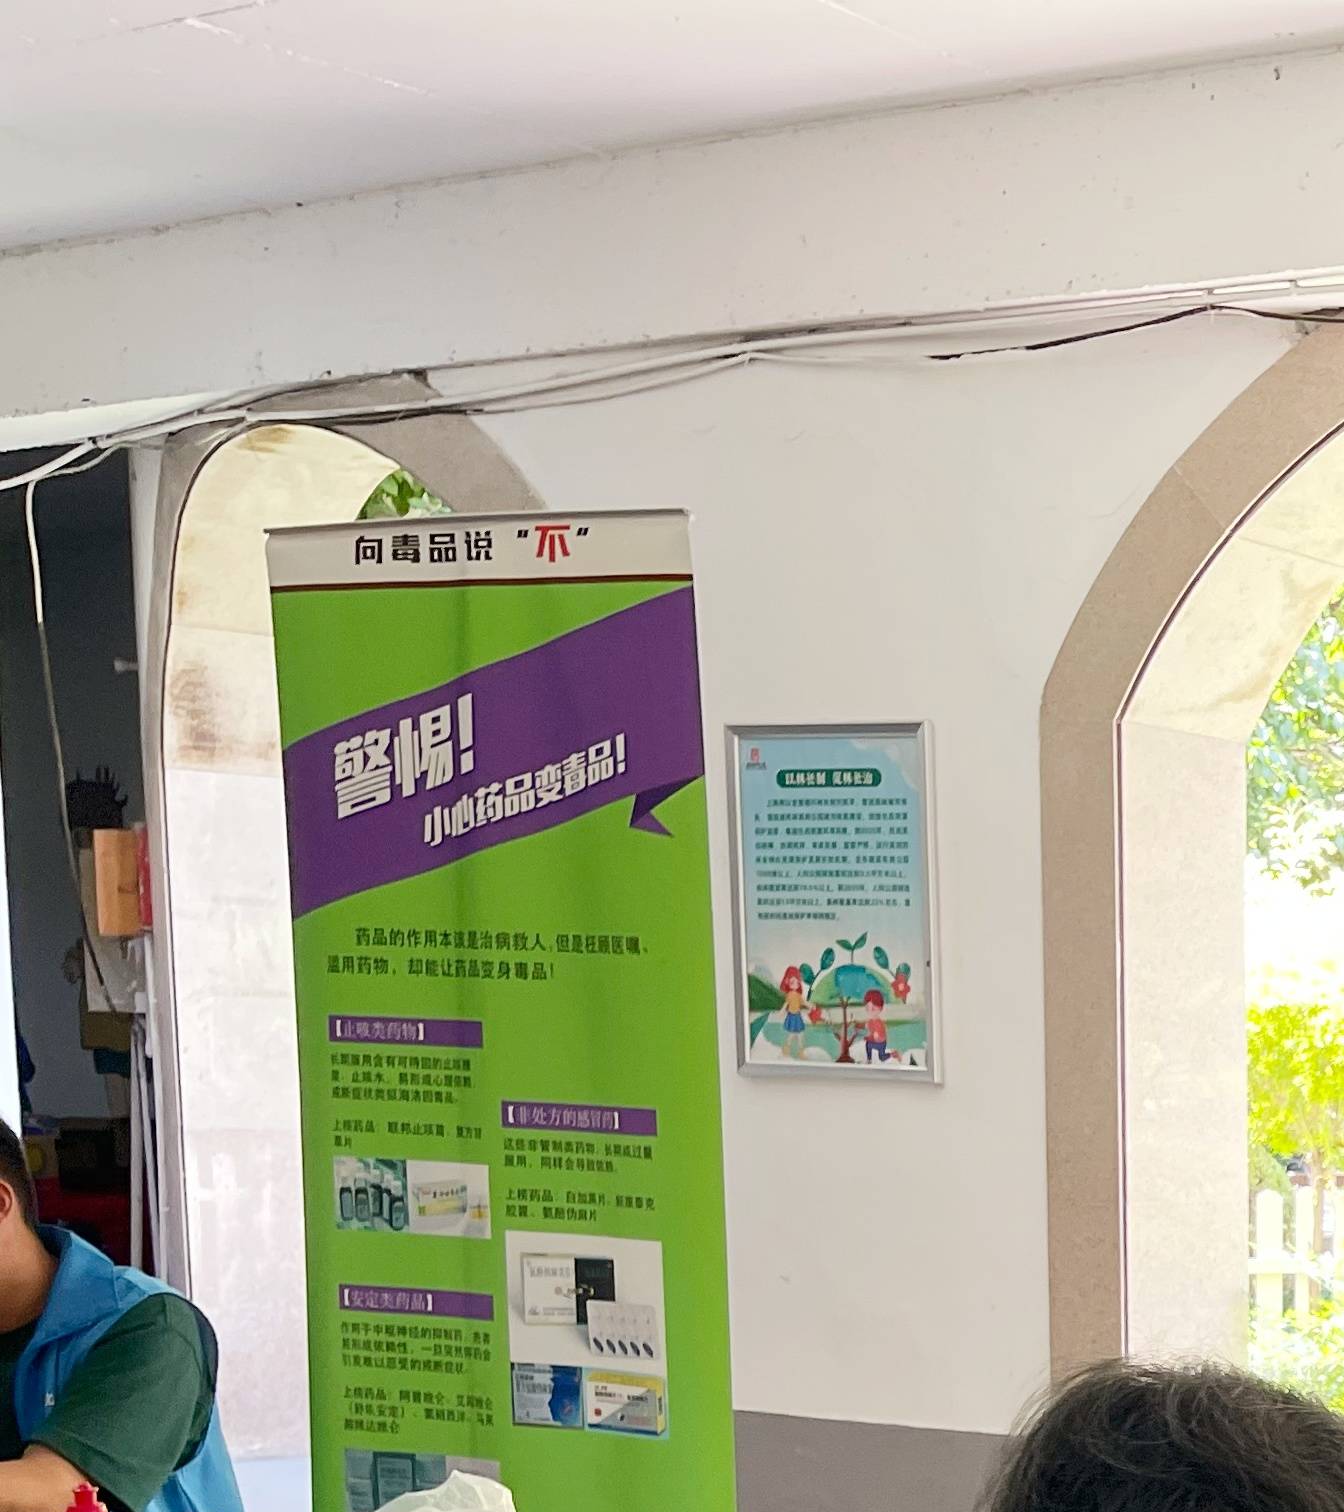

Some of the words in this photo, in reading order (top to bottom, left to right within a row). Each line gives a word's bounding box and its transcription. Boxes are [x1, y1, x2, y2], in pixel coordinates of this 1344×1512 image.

[422, 732, 629, 848] 小心药品变毒品！
